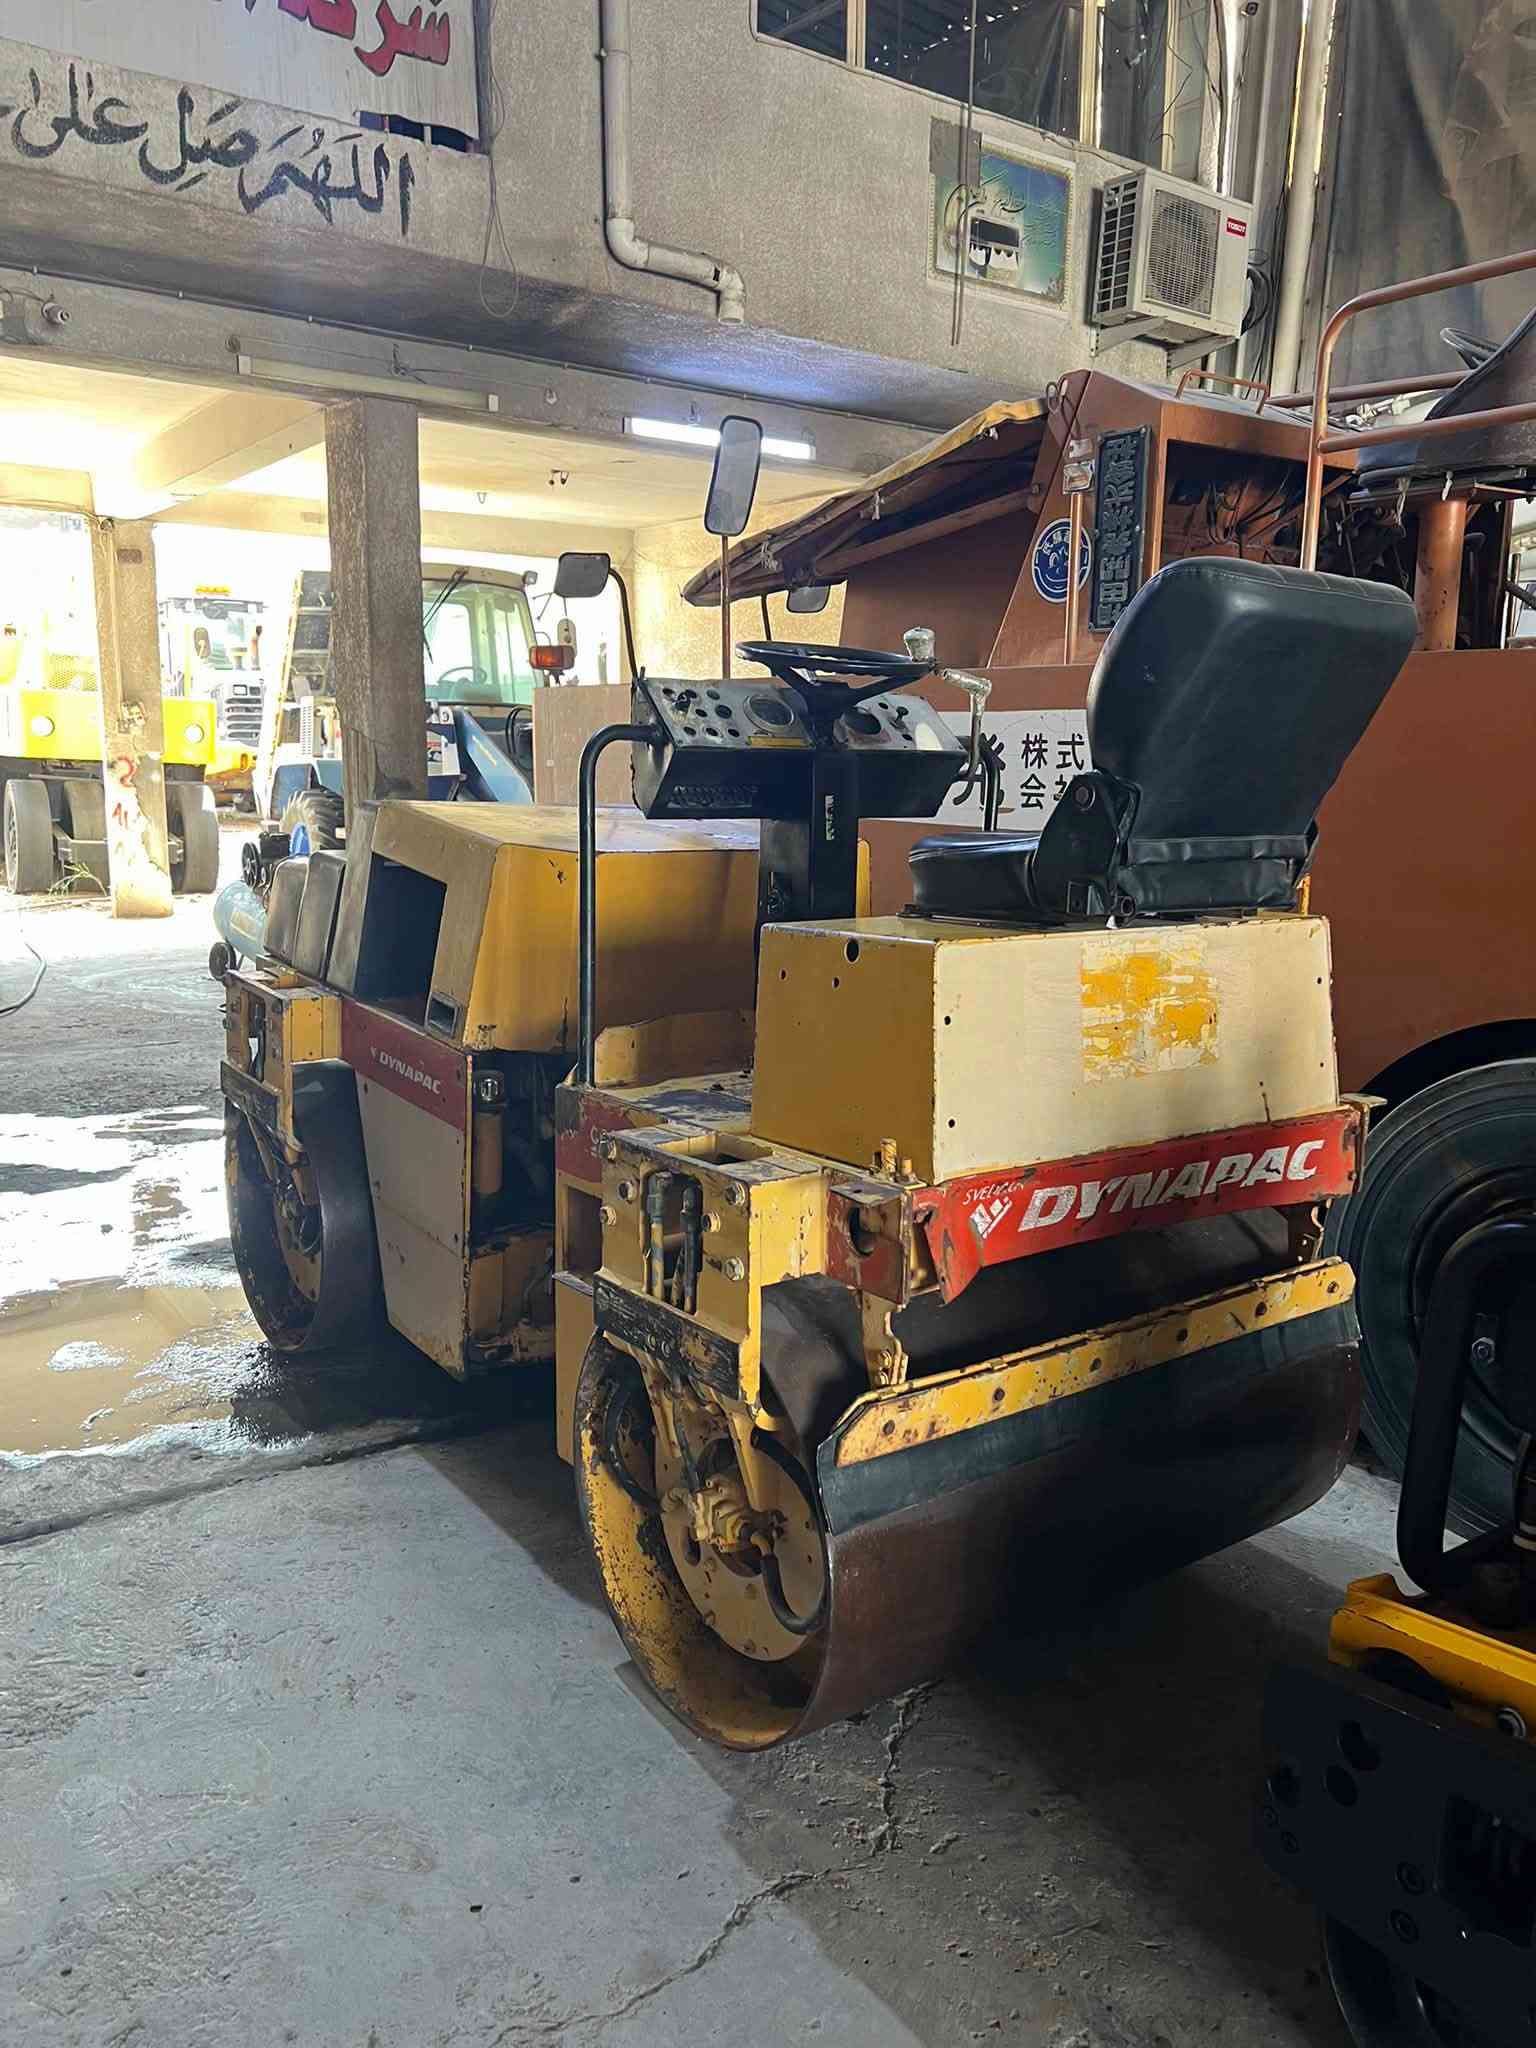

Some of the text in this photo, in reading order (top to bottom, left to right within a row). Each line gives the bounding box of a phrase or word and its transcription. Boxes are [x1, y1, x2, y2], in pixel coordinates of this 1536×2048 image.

[1021, 733, 1085, 770] 株式
[380, 1051, 441, 1095] DYNAPAC
[1018, 1140, 1325, 1232] DYNAPAC
